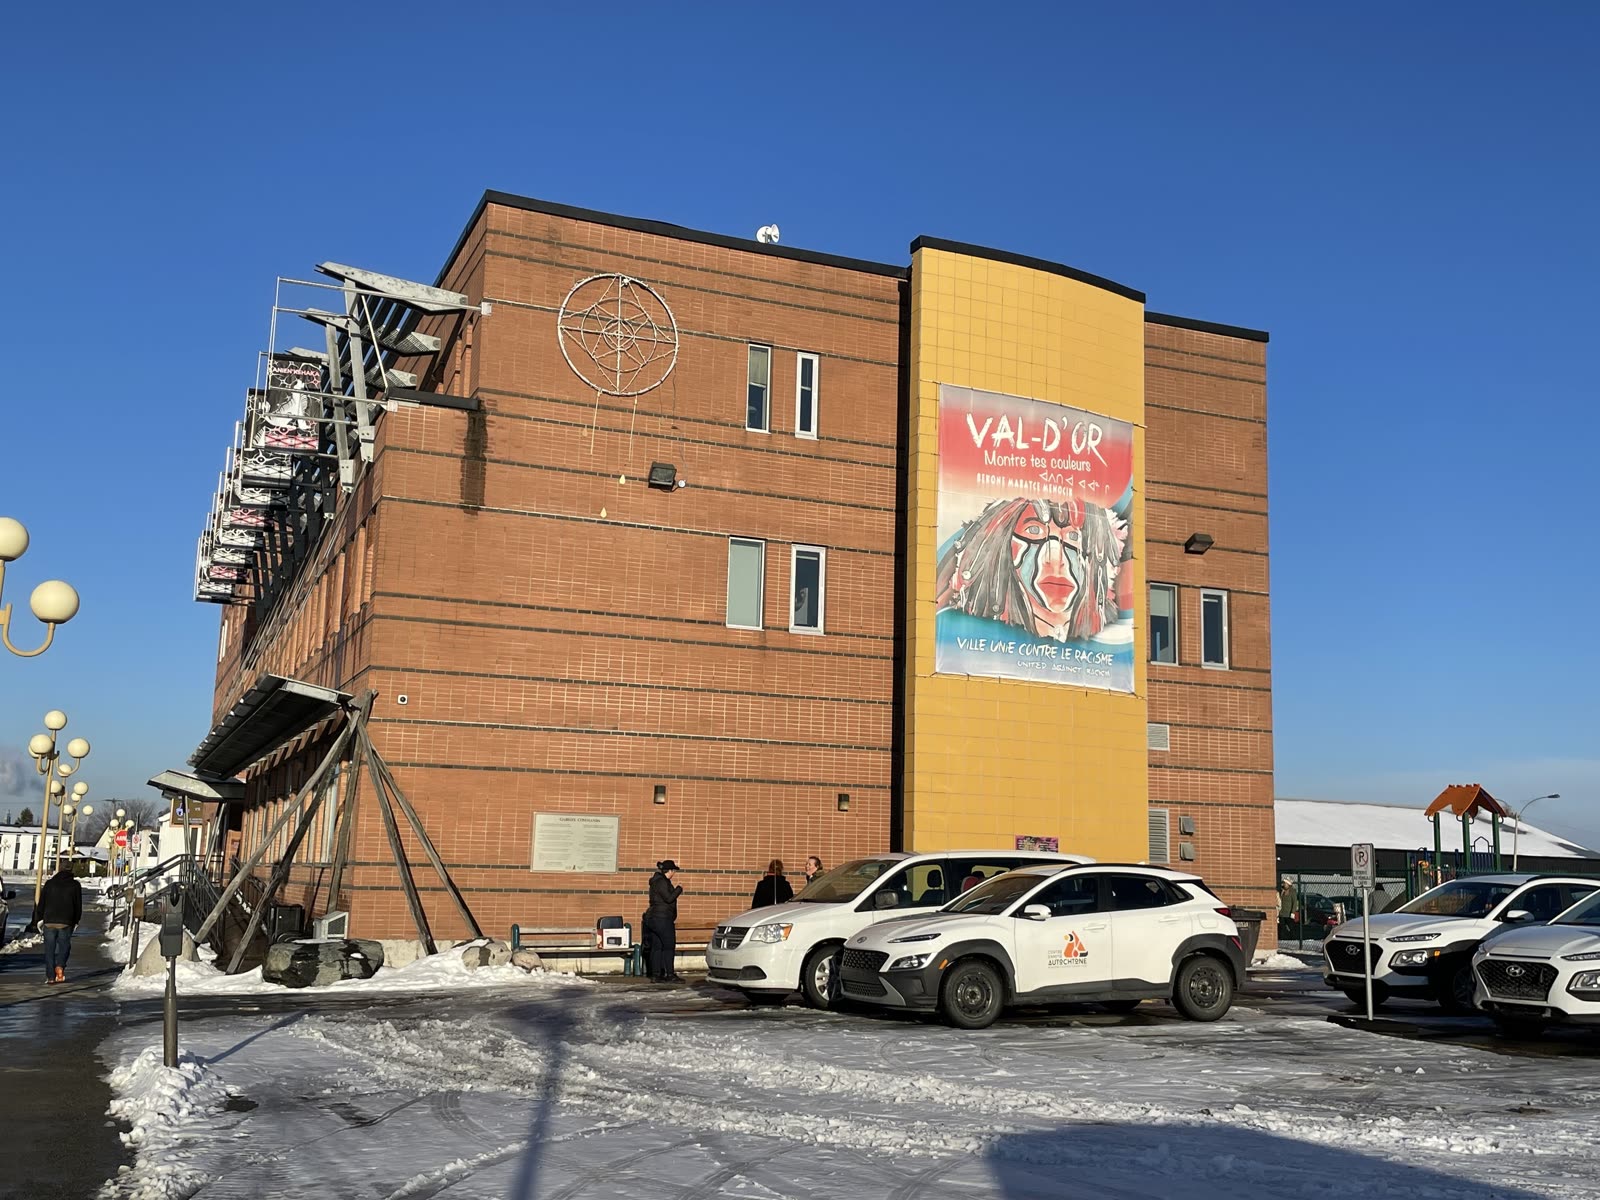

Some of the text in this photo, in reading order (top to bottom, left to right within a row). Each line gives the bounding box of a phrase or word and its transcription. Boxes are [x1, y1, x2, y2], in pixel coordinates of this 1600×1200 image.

[966, 413, 1108, 467] VAL-D'OR
[984, 450, 1091, 472] Montre tes couleurs
[957, 636, 1114, 666] VILLE UNIE CONTRE LE RACISME
[1017, 660, 1047, 670] UNITED
[1048, 958, 1087, 966] AUTOCHTONE
